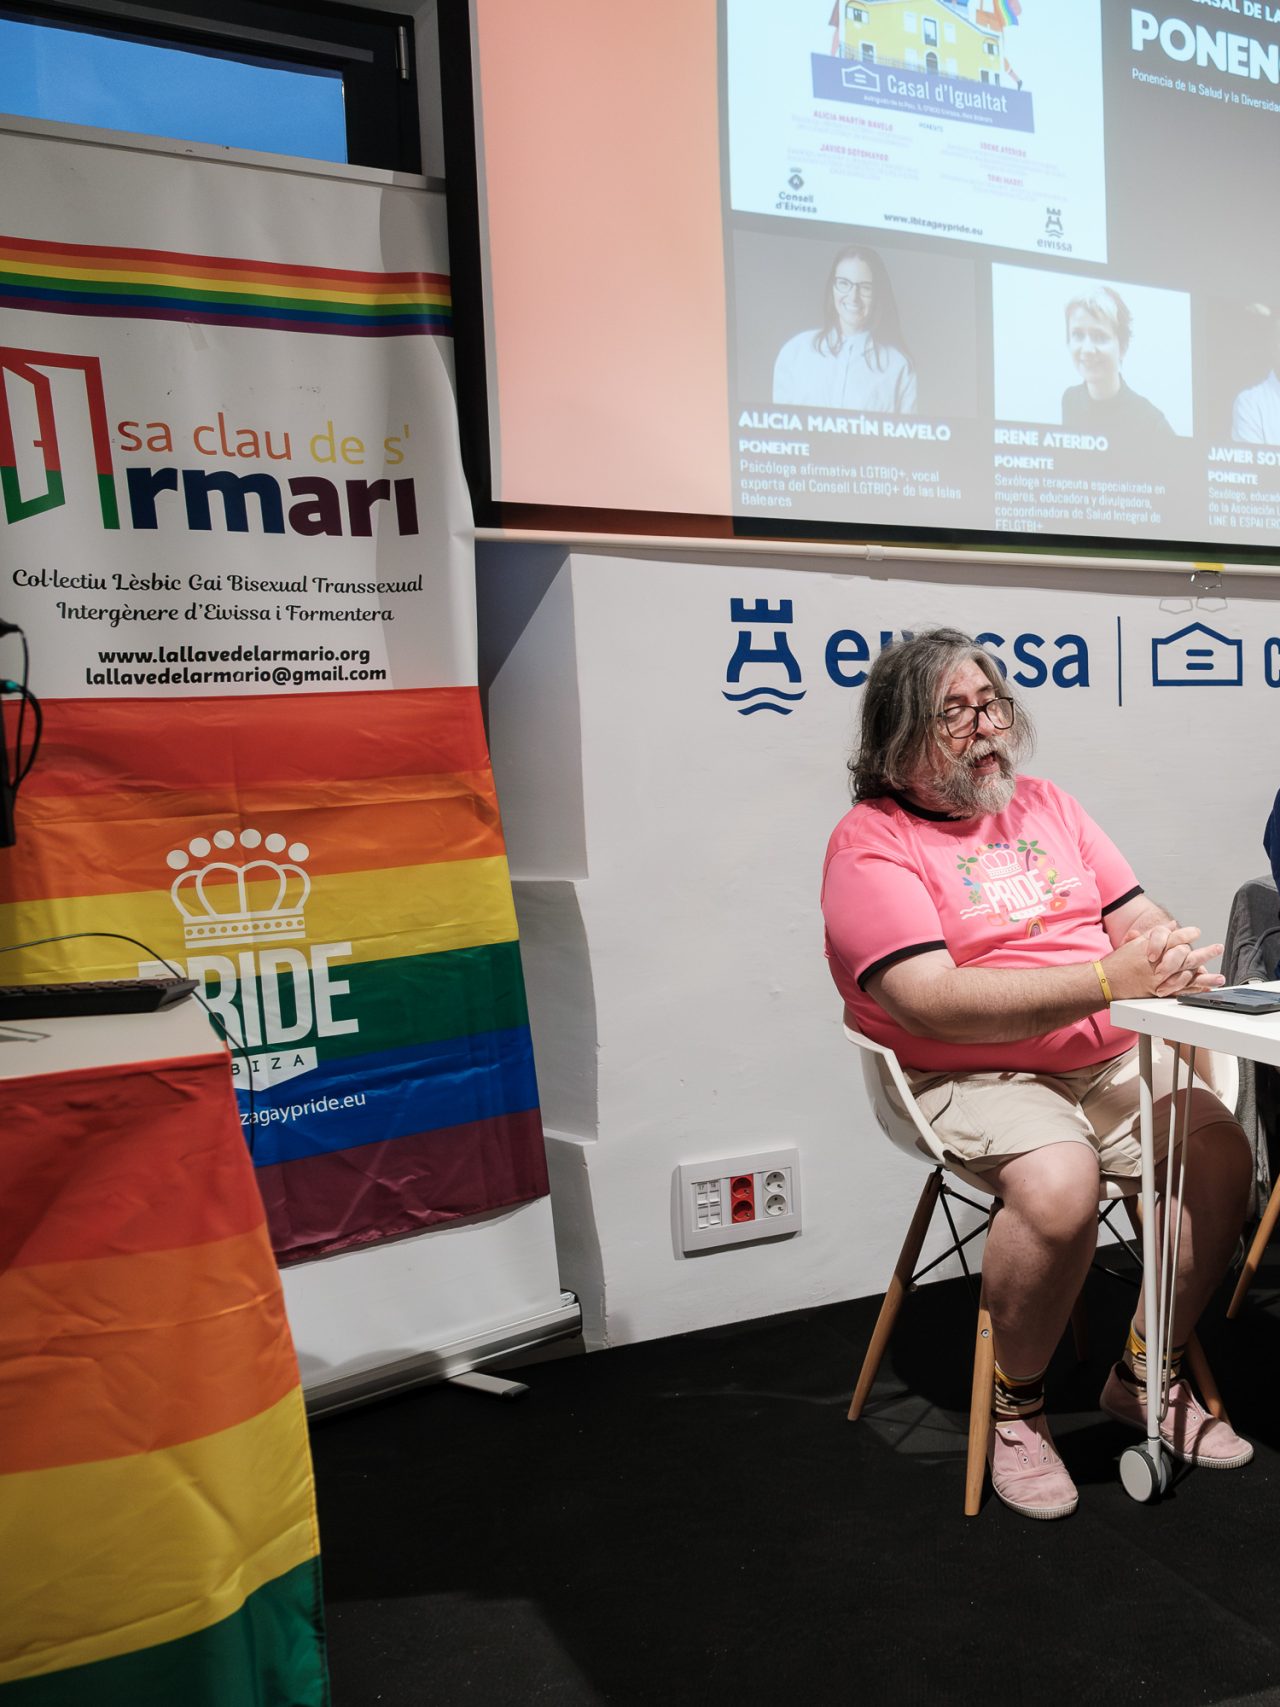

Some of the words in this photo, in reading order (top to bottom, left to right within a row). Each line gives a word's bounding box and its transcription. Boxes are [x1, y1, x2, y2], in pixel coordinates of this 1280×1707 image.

[1243, 0, 1262, 19] DE
[887, 74, 930, 101] Casal
[935, 83, 1008, 114] d'Igualtat
[1132, 68, 1173, 90] Ponencia
[1175, 78, 1186, 92] de
[1188, 81, 1197, 94] la
[1198, 83, 1222, 101] Salud
[1224, 91, 1231, 104] y
[1231, 91, 1240, 104] la
[778, 191, 815, 203] Consell
[884, 212, 983, 236] www.ibizagaypride.eu
[738, 411, 802, 431] ALICIA
[808, 415, 880, 437] MARTÍN
[883, 421, 951, 441] RAVELO
[117, 420, 173, 453] sa
[193, 411, 292, 461] clau
[309, 419, 366, 465] de
[383, 424, 410, 465] s'
[738, 440, 810, 456] PONENTE
[994, 428, 1039, 447] IRENE
[1043, 432, 1109, 451] ATERIDO
[994, 455, 1055, 470] PONENTE
[1208, 447, 1253, 465] JAVIER
[740, 459, 797, 478] Psicóloga
[801, 462, 856, 477] afirmativa
[912, 471, 940, 482] vocal
[1207, 469, 1259, 485] PONENTE
[741, 478, 784, 493] experta
[788, 480, 806, 492] del
[808, 481, 850, 494] Consell
[903, 485, 916, 497] de
[937, 486, 962, 499] Islas
[994, 474, 1040, 490] Sexóloga
[1042, 477, 1089, 491] terapeuta
[1091, 479, 1152, 494] especializada
[1154, 485, 1166, 495] en
[741, 492, 792, 507] Baleares
[1040, 493, 1089, 505] educadora
[1071, 507, 1083, 519] de
[1086, 508, 1112, 521] Salud
[1114, 510, 1148, 525] Integral
[1150, 512, 1161, 523] de
[1208, 515, 1228, 528] LINE
[1239, 516, 1264, 529] ESPAI
[112, 572, 182, 591] Lèsbic
[188, 574, 223, 592] Gai
[226, 574, 309, 593] Bisexual
[312, 574, 424, 594] Transsexual
[56, 601, 179, 628] Intergènere
[276, 605, 283, 621] i
[285, 604, 395, 622] Formentera
[98, 645, 370, 665] www.lallavedelarmario.org
[86, 665, 387, 686] lallavedelarmario@gmail.com
[982, 868, 1054, 914] PRIDE
[232, 1054, 305, 1076] BIZA
